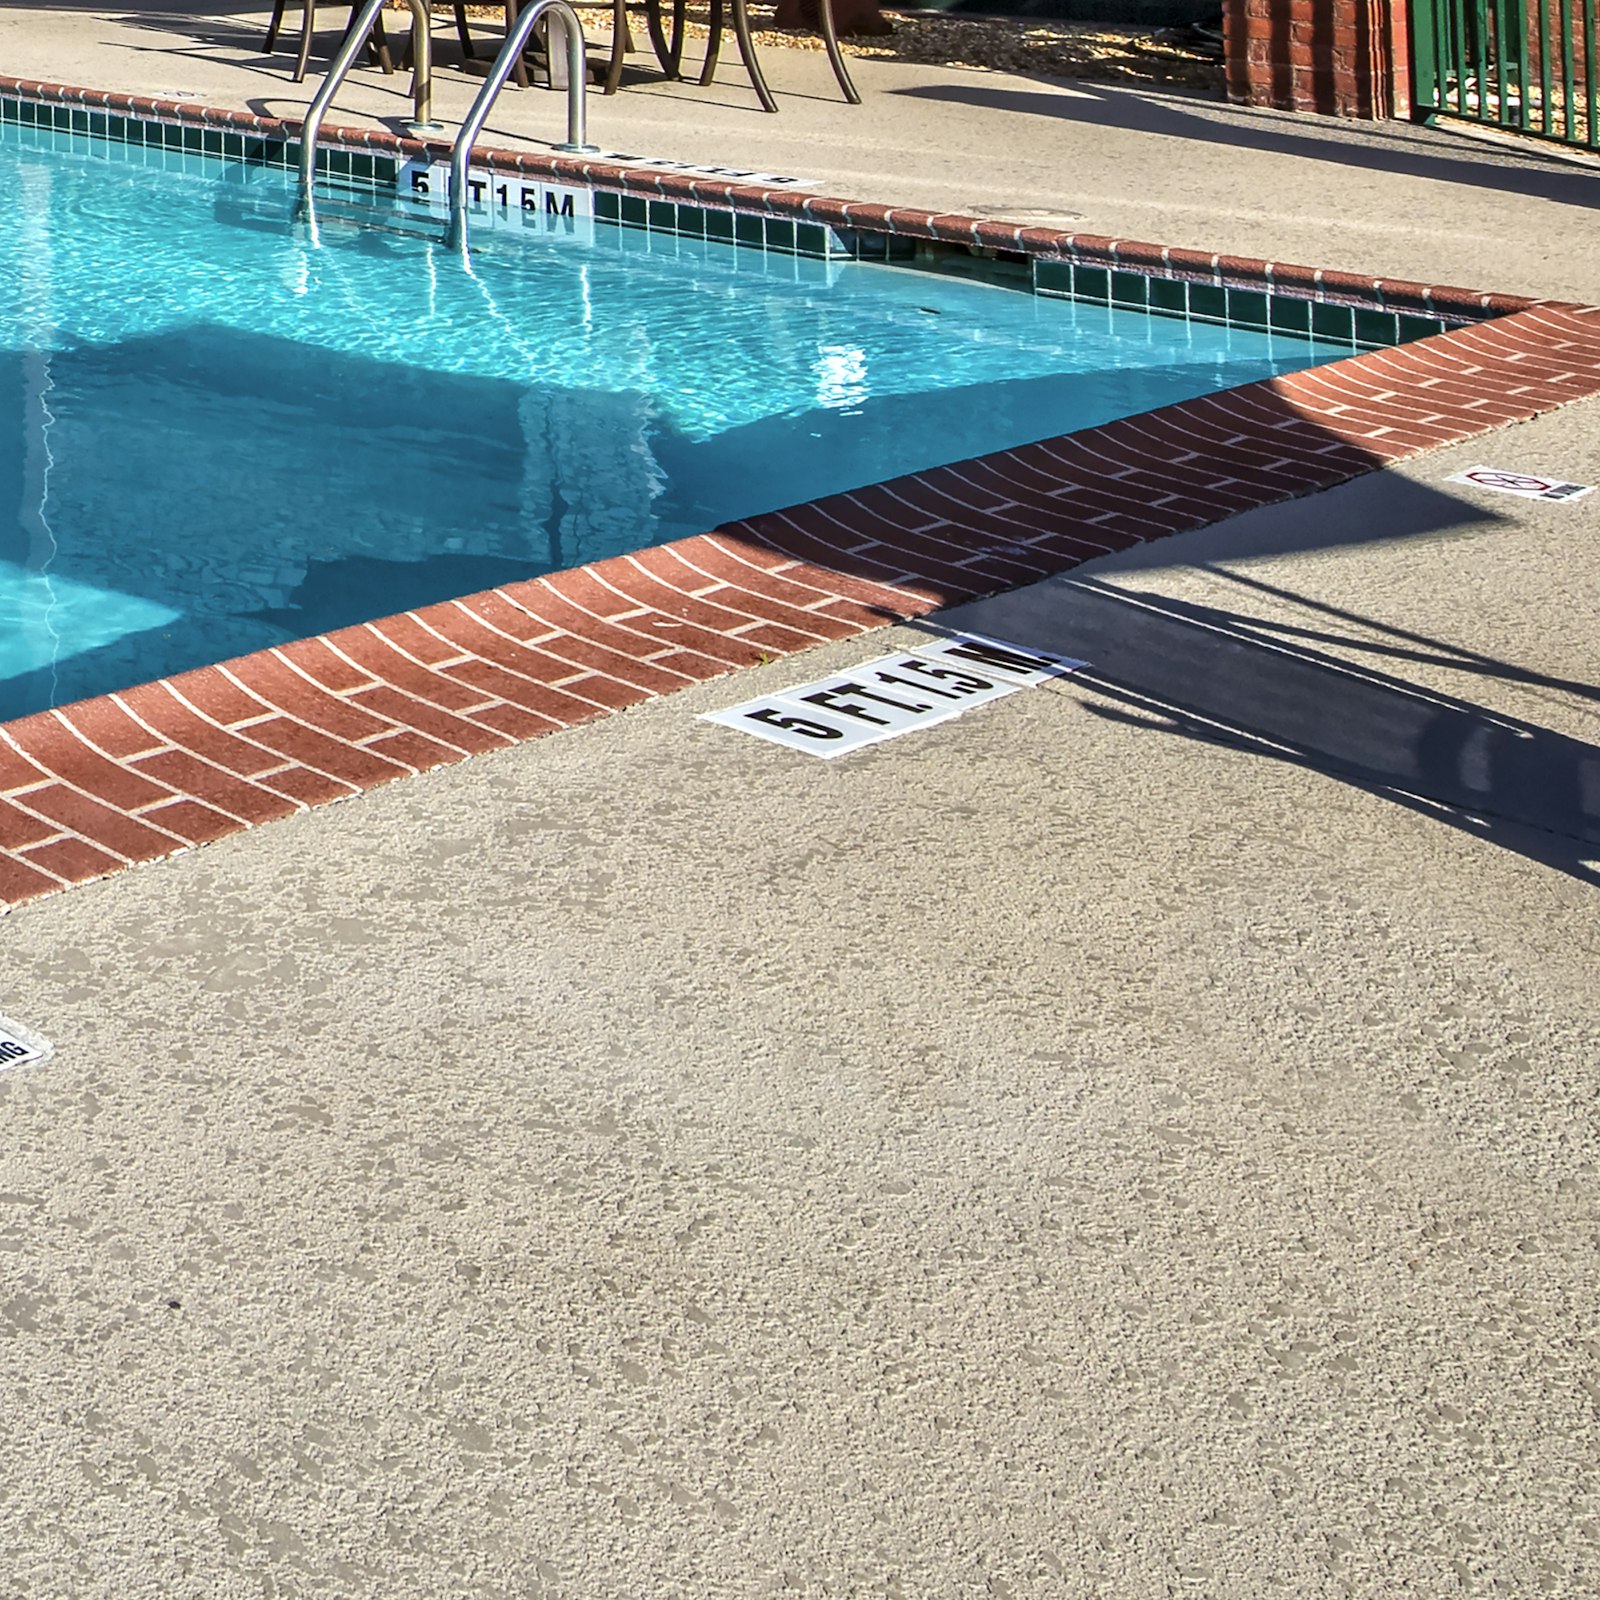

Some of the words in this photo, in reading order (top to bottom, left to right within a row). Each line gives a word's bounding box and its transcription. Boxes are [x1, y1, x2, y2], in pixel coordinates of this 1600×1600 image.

[412, 170, 429, 194] 5
[546, 191, 574, 218] M
[744, 708, 844, 740] 5
[875, 659, 994, 700] 1.5
